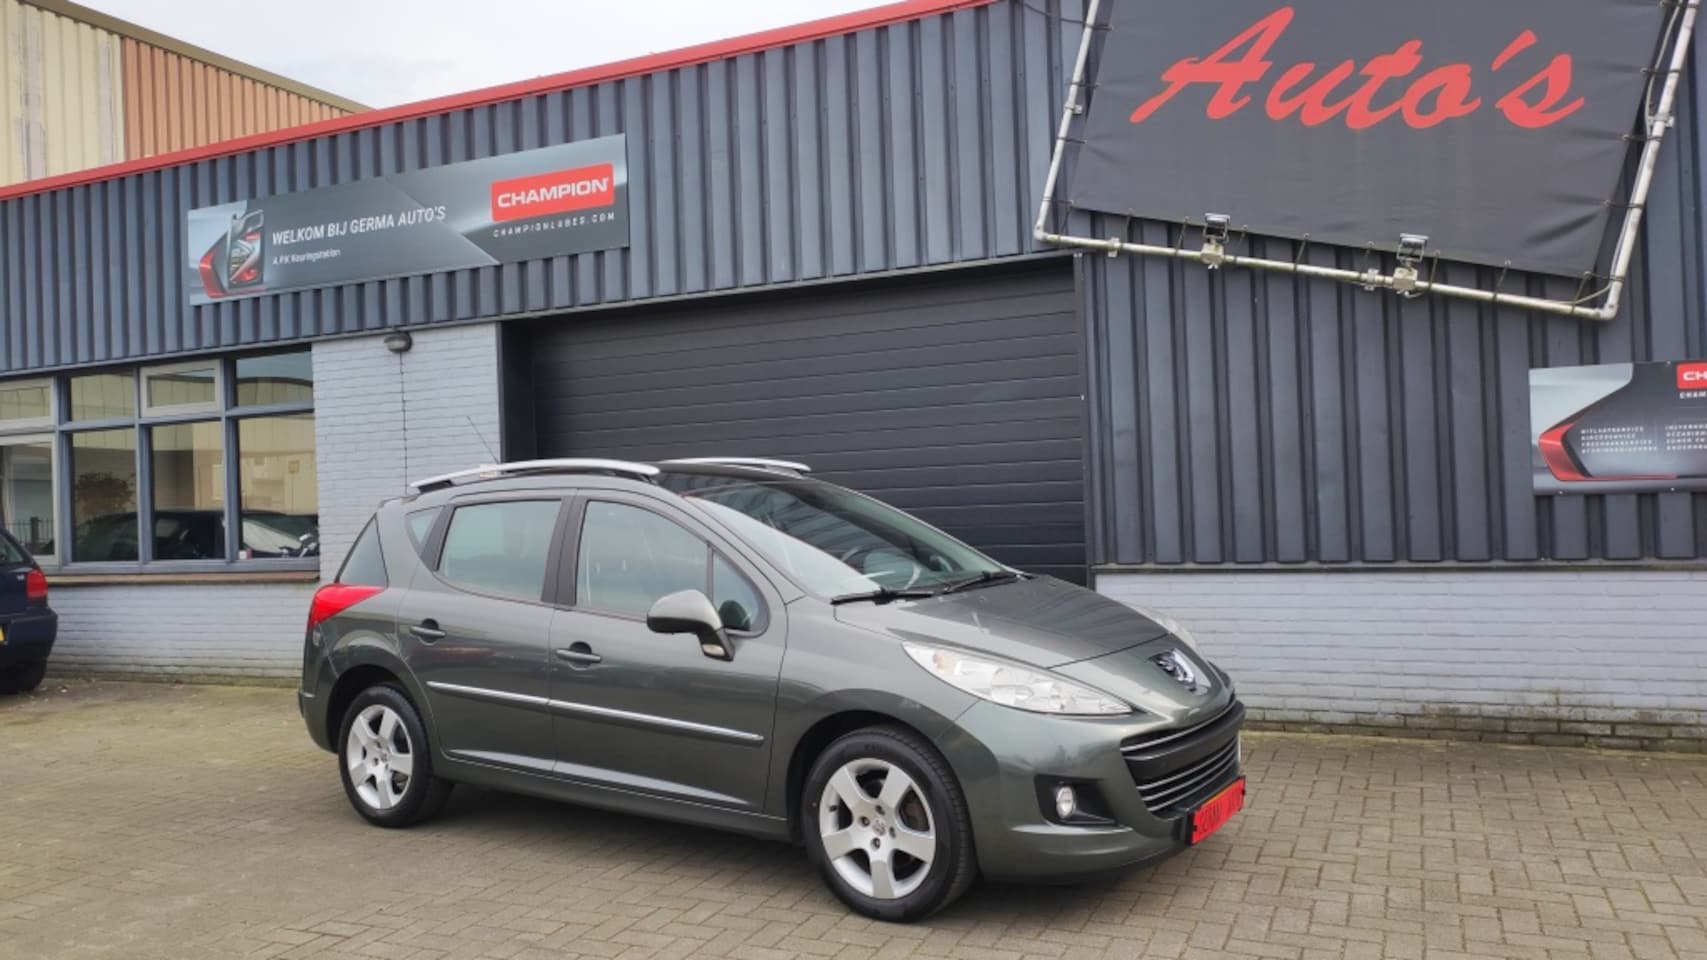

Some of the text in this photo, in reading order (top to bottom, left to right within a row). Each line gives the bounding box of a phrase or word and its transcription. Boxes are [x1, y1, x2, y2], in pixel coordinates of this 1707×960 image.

[1130, 6, 1585, 129] Auto's
[498, 178, 608, 208] CHAMPION
[272, 205, 446, 246] WELKOM BIJ GERMA AUTO'S
[493, 212, 615, 238] CHAMPIONLUBES.COM
